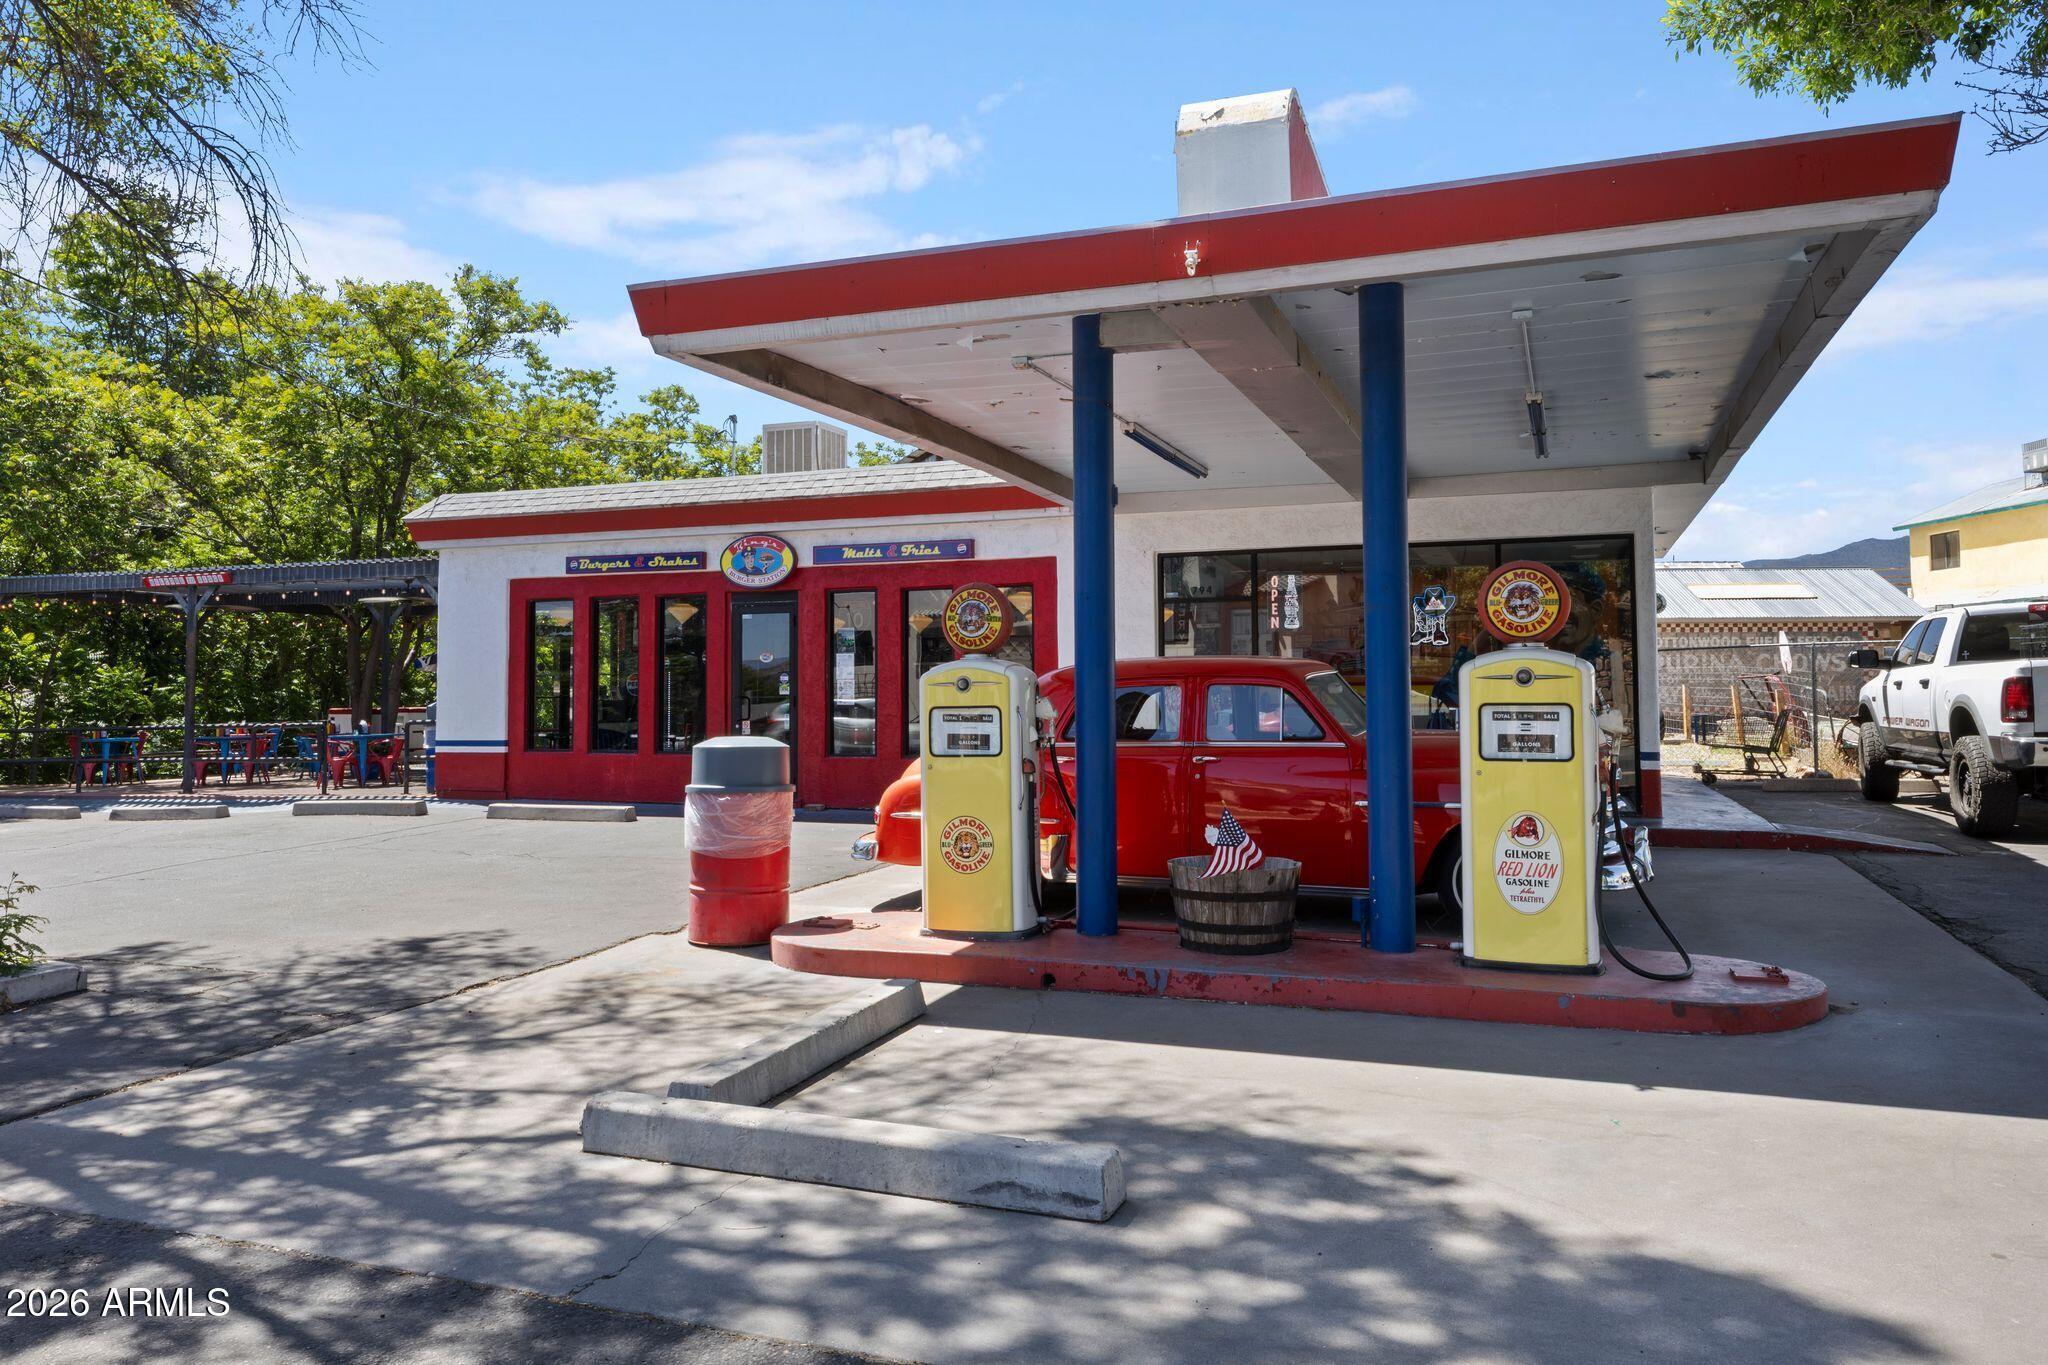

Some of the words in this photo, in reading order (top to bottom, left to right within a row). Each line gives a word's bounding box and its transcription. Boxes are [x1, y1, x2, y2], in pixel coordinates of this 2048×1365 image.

[842, 547, 883, 559] Malts
[886, 545, 897, 557] &
[901, 544, 941, 556] Fries
[579, 560, 631, 570] Burgers
[634, 556, 645, 567] &
[648, 556, 699, 567] Shakes
[729, 570, 756, 584] BURGER
[758, 568, 786, 583] STATION
[1492, 571, 1555, 597] GILMORE
[950, 591, 1000, 613] GILMORE
[1270, 575, 1280, 628] OPEN
[1492, 609, 1554, 633] GASOLINE
[949, 625, 998, 647] GASOLINE
[1657, 636, 1742, 648] OTTONWOOD
[1905, 718, 1930, 728] WAGON
[943, 819, 990, 840] GILMORE
[944, 850, 990, 872] GASOLINE
[1505, 849, 1551, 860] GILMORE
[1497, 861, 1524, 877] RED
[1525, 863, 1559, 879] LION
[1505, 878, 1550, 888] GASOLINE
[1519, 887, 1535, 895] plus
[1510, 895, 1545, 904] TETRAETHYL
